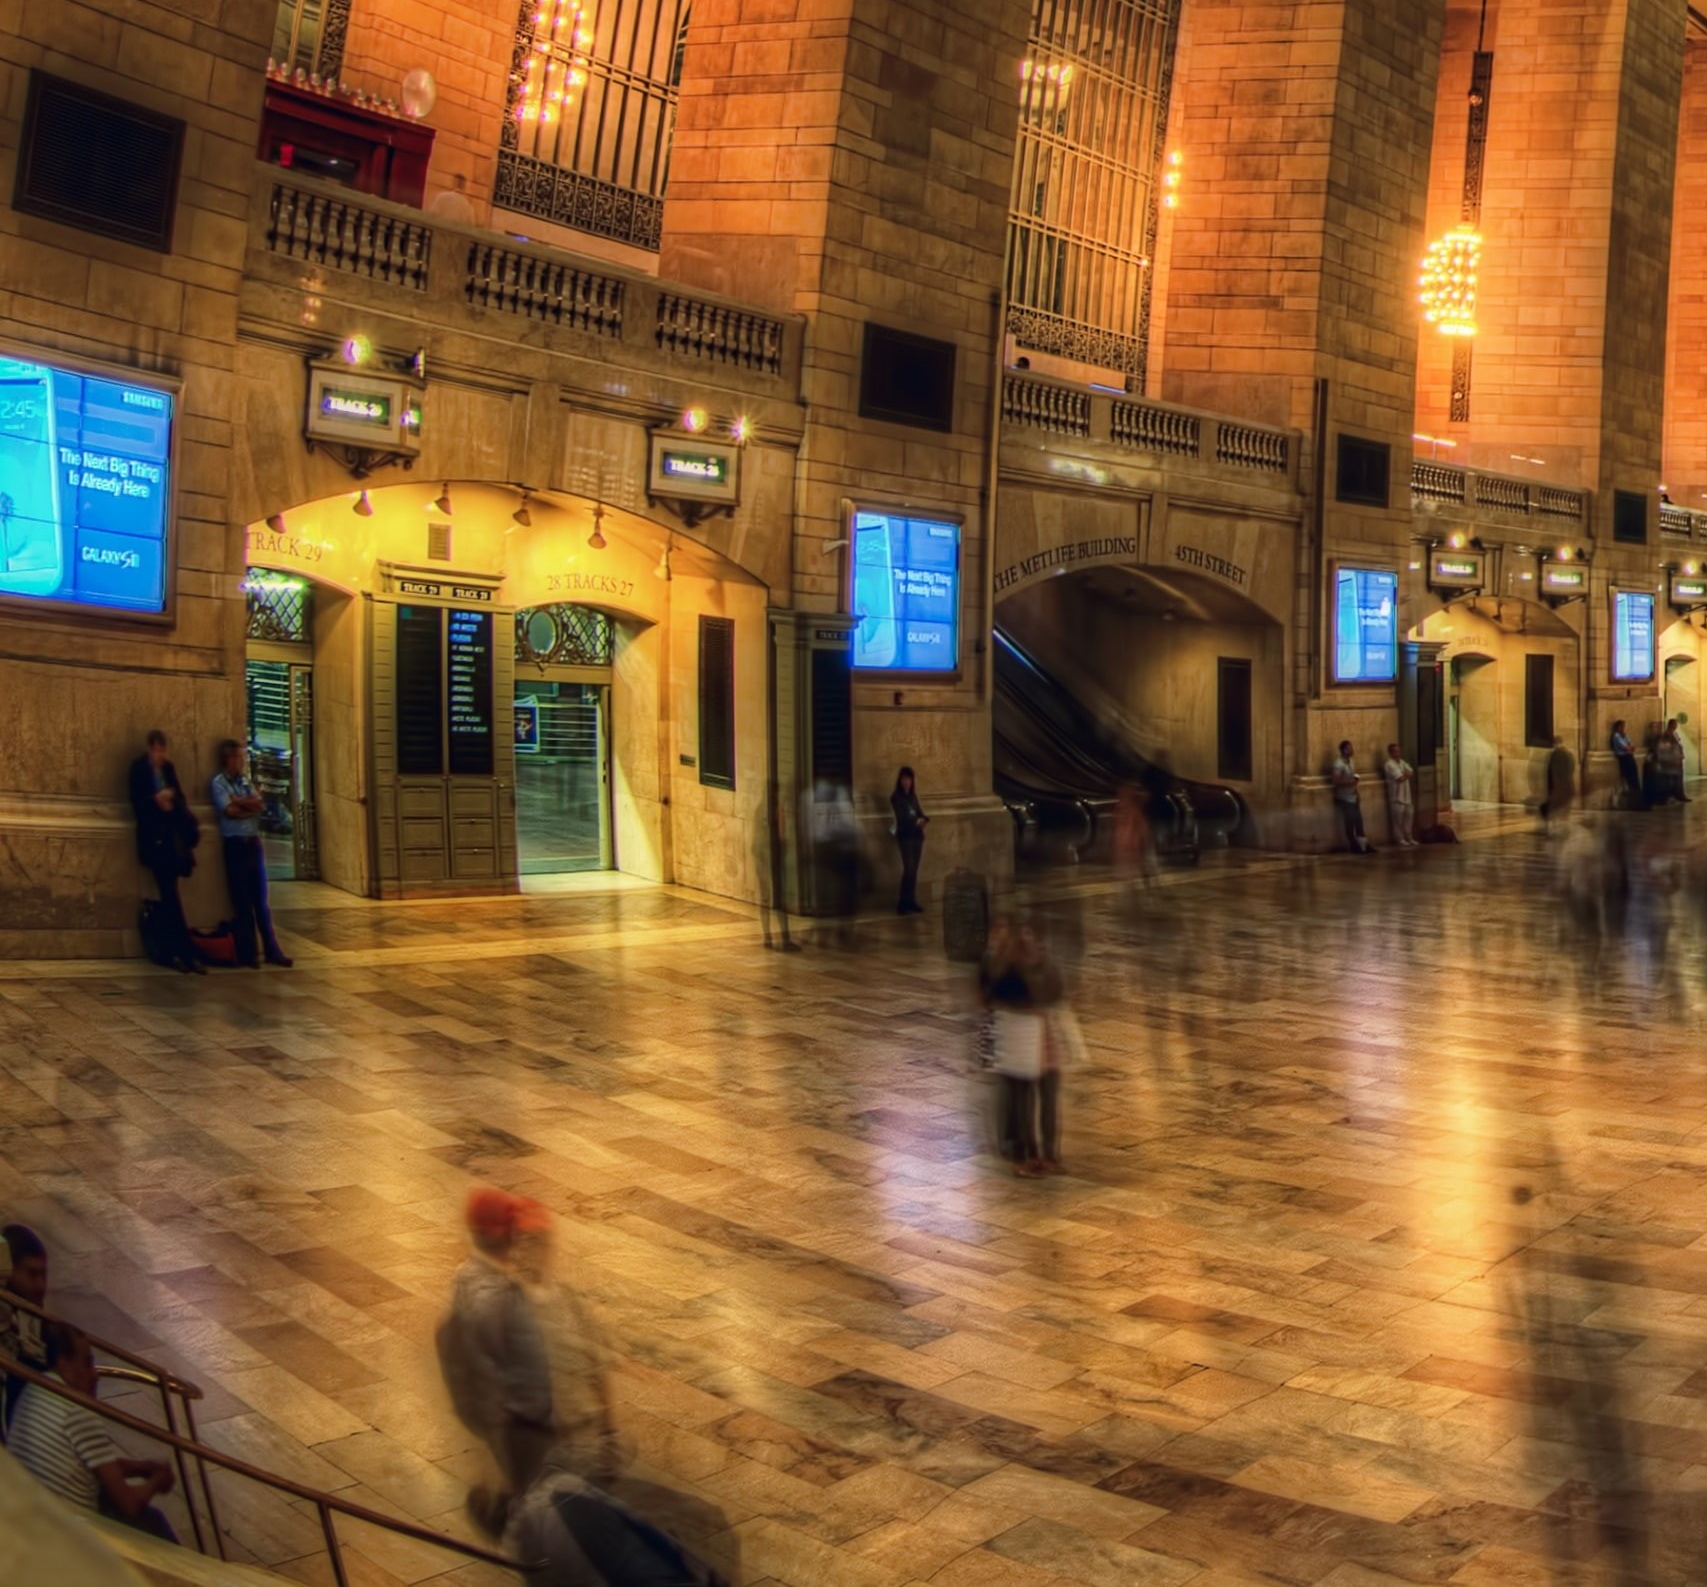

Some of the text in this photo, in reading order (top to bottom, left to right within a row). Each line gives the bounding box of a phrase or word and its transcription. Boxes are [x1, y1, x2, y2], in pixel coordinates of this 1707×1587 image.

[60, 447, 160, 483] The Next Big Thing
[69, 470, 149, 498] Is Already Here
[305, 543, 322, 562] 29
[403, 583, 428, 594] TRACK
[455, 589, 478, 599] TRACK
[563, 573, 617, 594] TRACKS
[619, 580, 634, 597] 27
